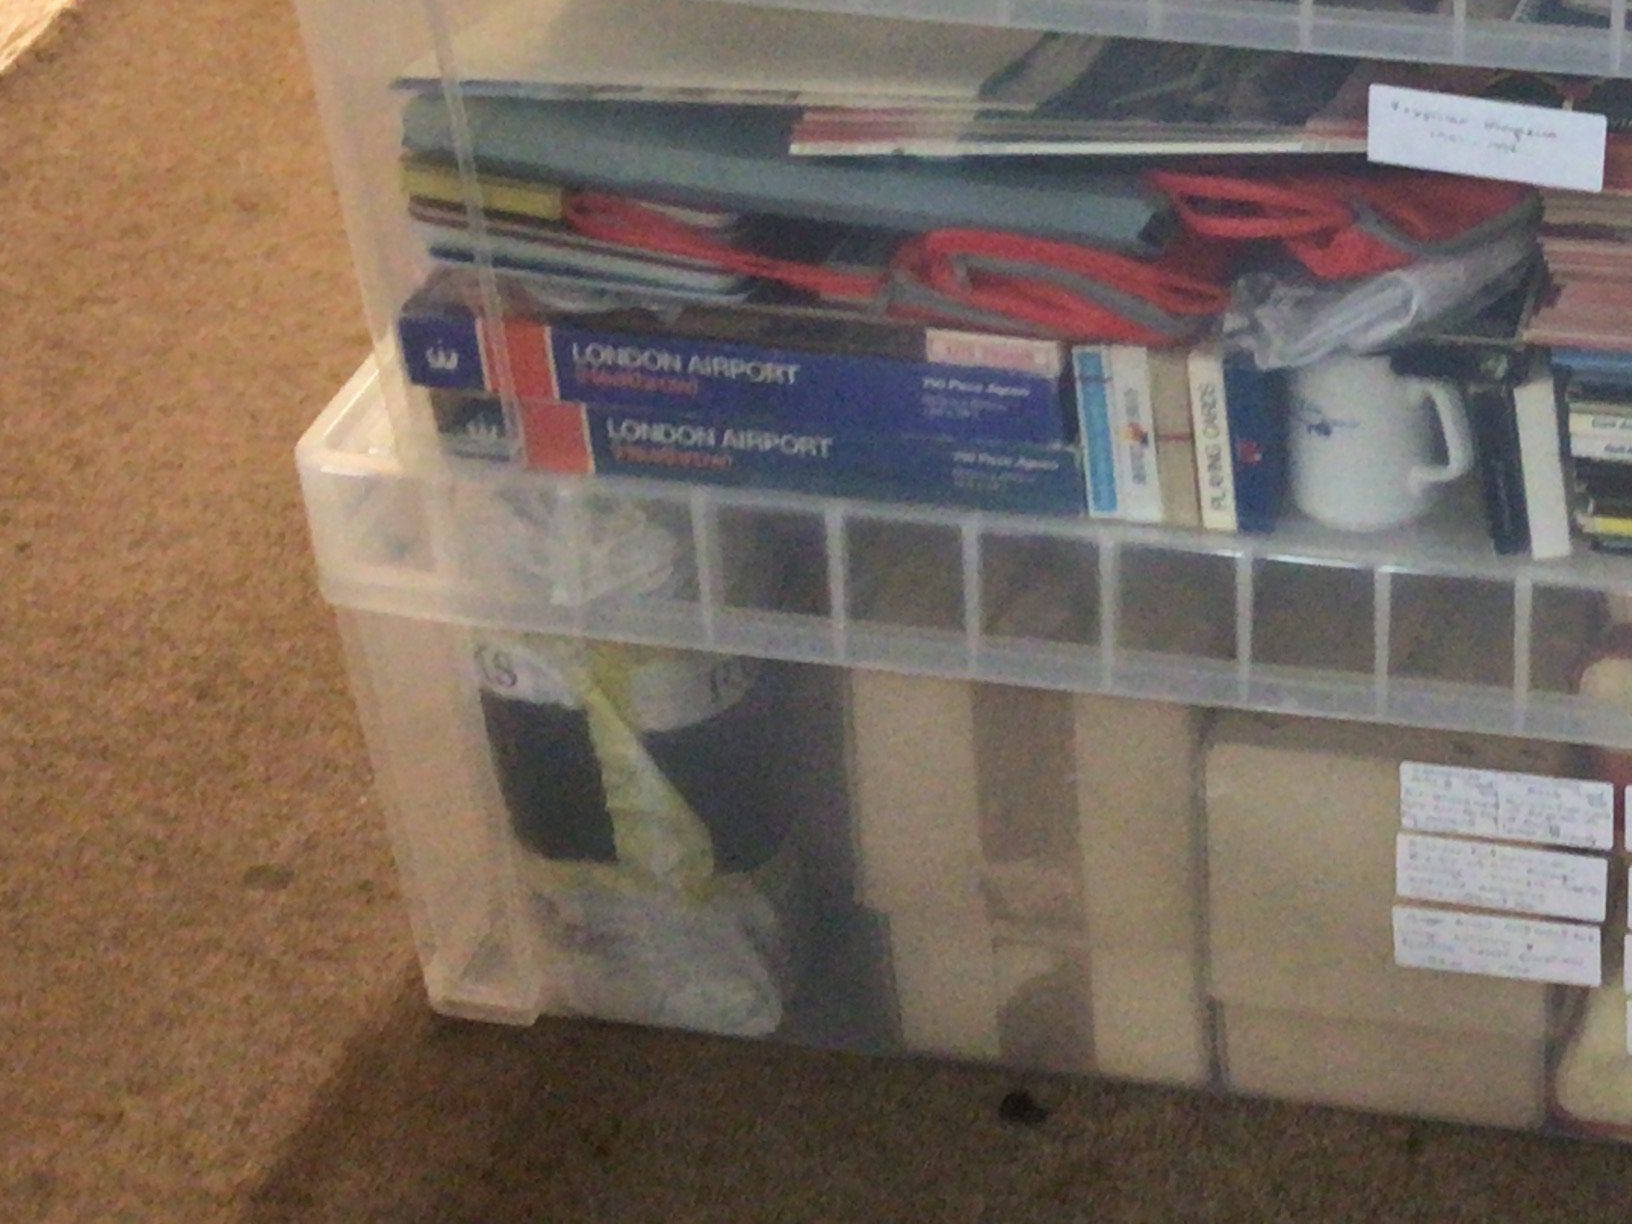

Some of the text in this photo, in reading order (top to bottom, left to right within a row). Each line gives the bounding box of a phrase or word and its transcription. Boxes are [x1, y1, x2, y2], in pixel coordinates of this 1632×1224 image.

[572, 342, 800, 384] LONDON AIRPORT
[607, 417, 834, 458] LONDON AIRPORT
